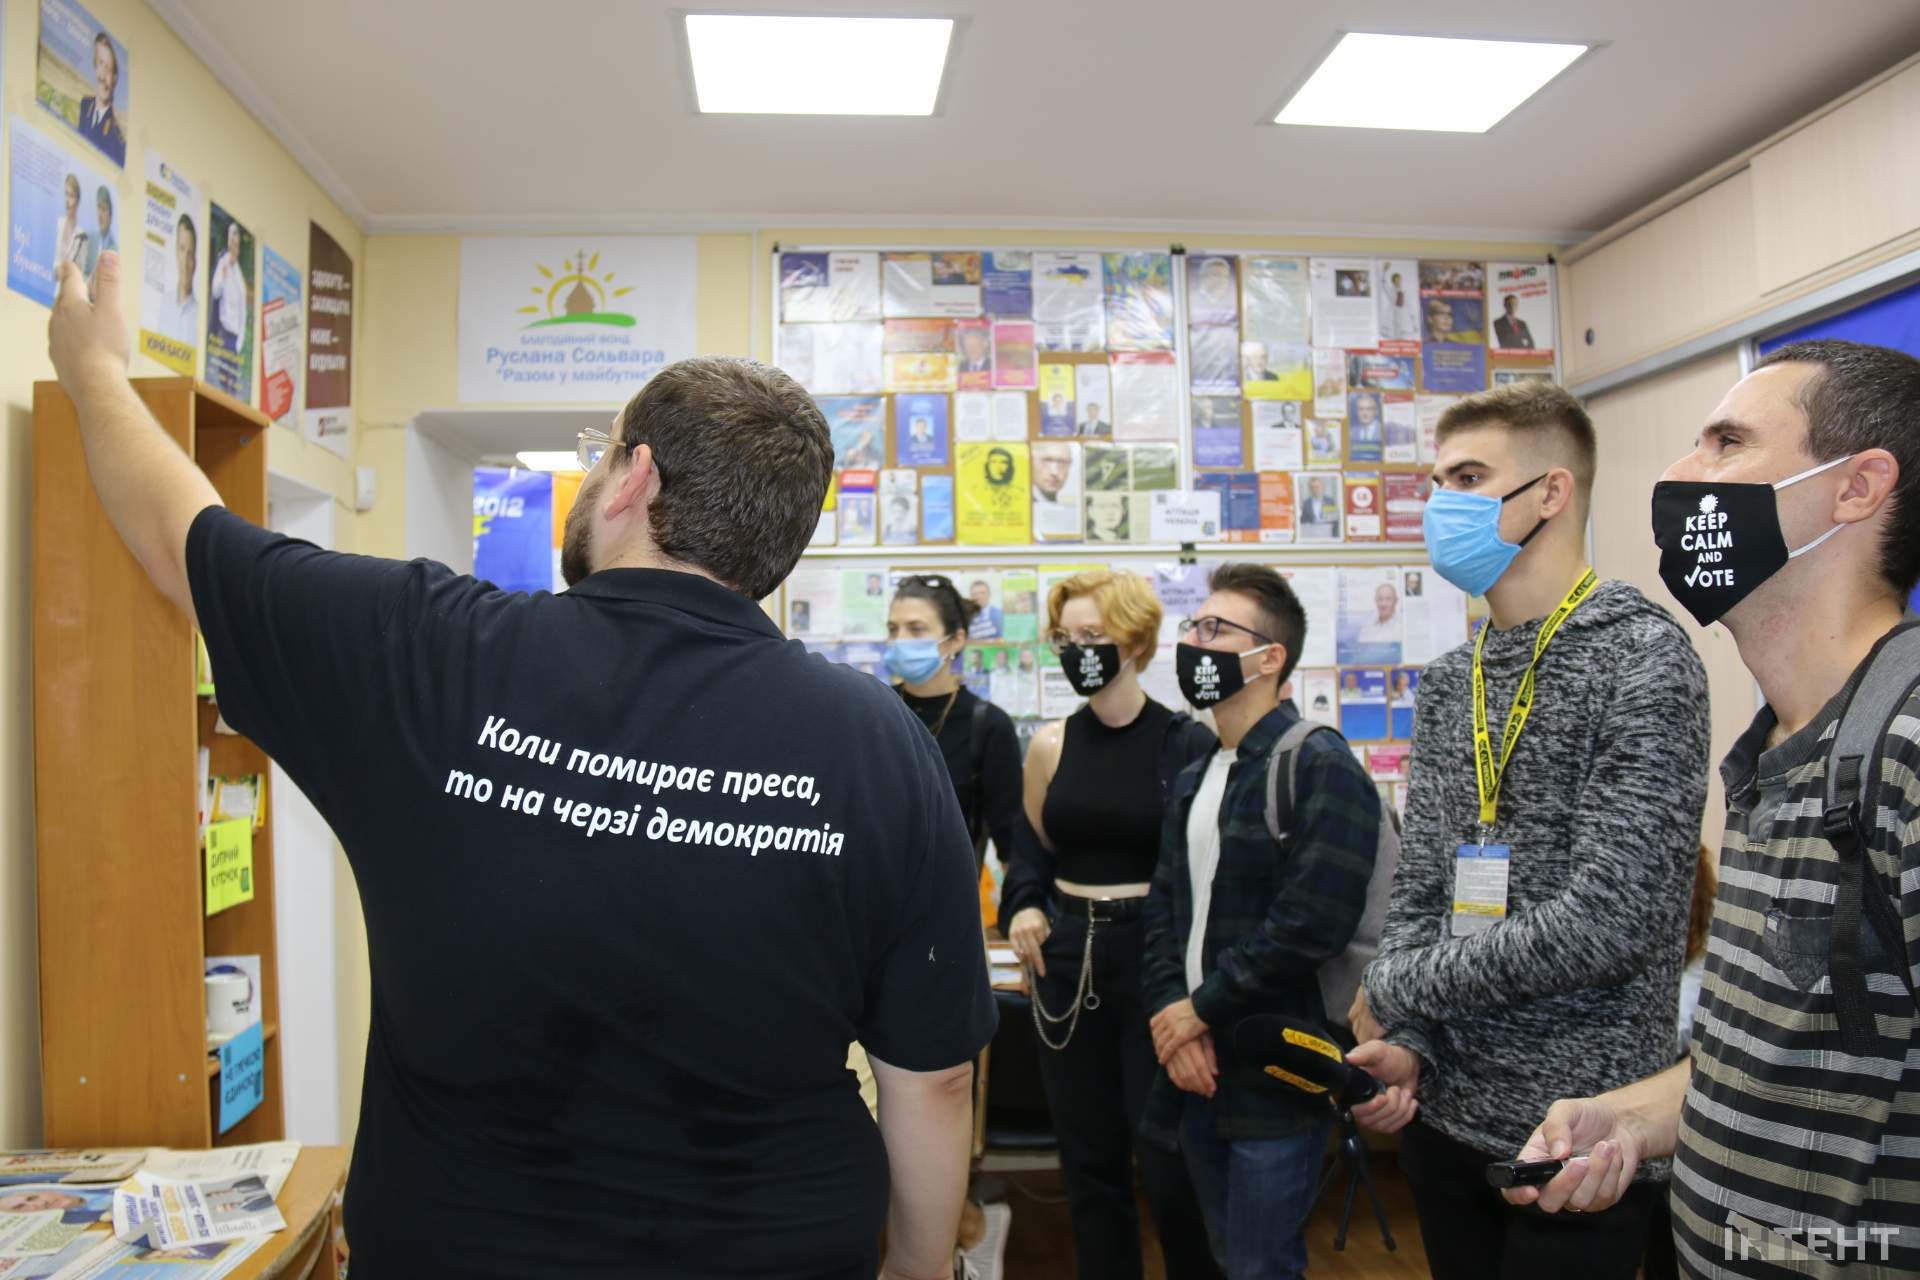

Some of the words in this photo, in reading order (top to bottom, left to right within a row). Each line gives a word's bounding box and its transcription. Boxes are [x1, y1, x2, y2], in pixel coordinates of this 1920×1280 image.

[486, 347, 566, 367] Руслана
[572, 347, 666, 366] Сольвара
[558, 370, 568, 385] у
[1685, 512, 1728, 532] KEEP
[1681, 531, 1733, 551] CALM
[1697, 551, 1723, 564] AND
[1684, 565, 1735, 588] VOTE
[1194, 674, 1220, 684] CALM
[1195, 664, 1218, 675] KEEP
[477, 715, 562, 765] Коли
[566, 748, 715, 794] помирає
[721, 770, 822, 807] преса,
[445, 769, 493, 802] то
[500, 783, 545, 816] на
[553, 796, 642, 837] черзі
[646, 806, 845, 857] демократія
